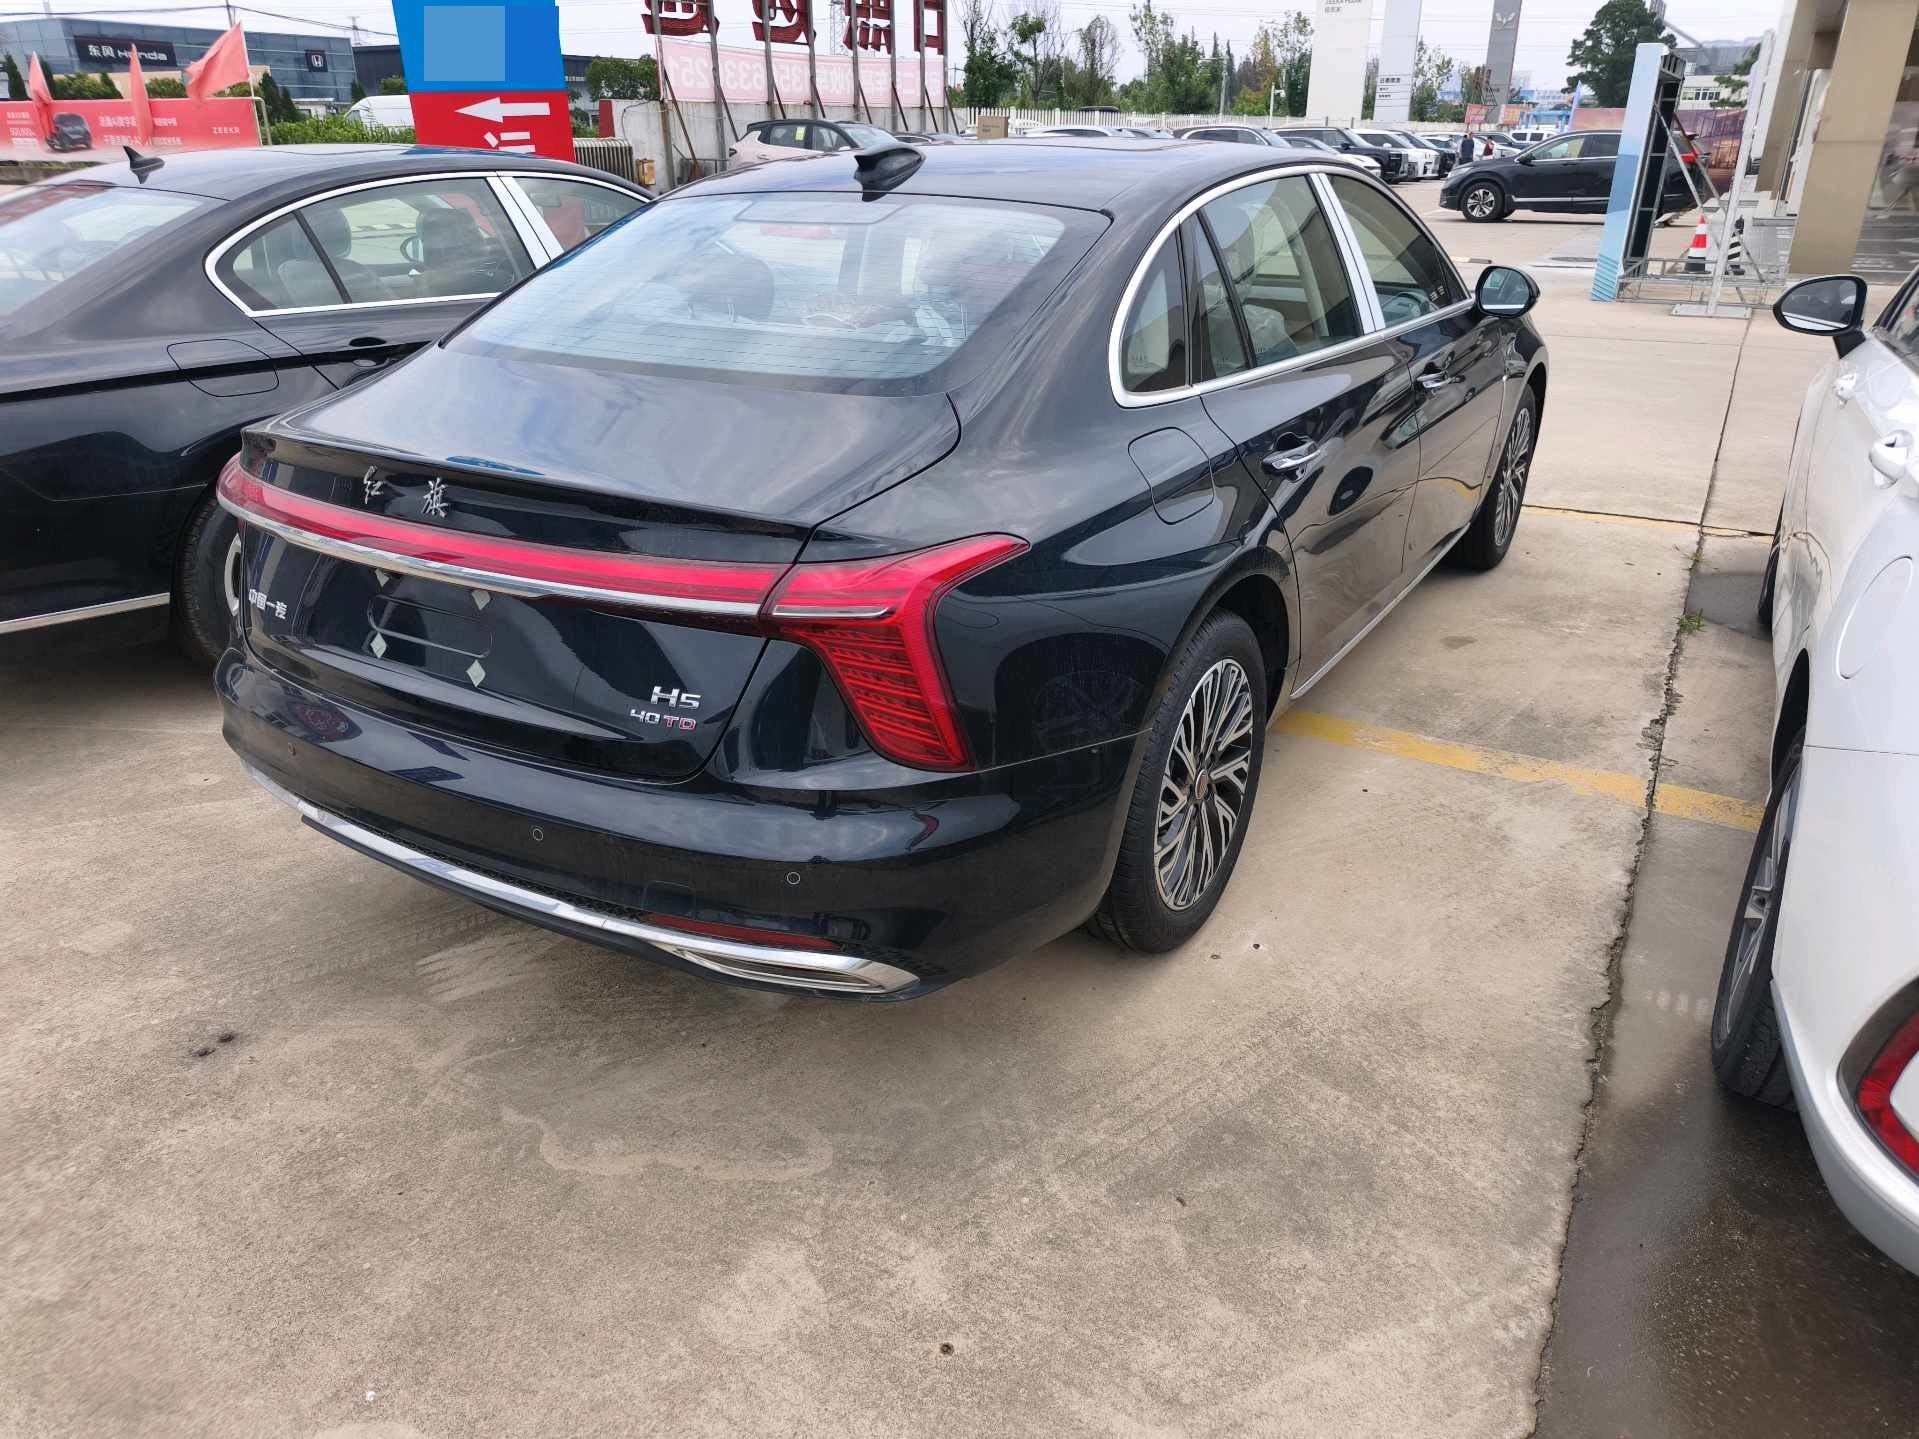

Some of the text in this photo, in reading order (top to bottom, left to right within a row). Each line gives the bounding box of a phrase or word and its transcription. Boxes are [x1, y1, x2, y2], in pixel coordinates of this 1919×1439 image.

[117, 49, 168, 61] Hnda
[211, 126, 240, 135] ZEEKR
[248, 588, 288, 620] 中国一汽
[650, 686, 702, 710] H5
